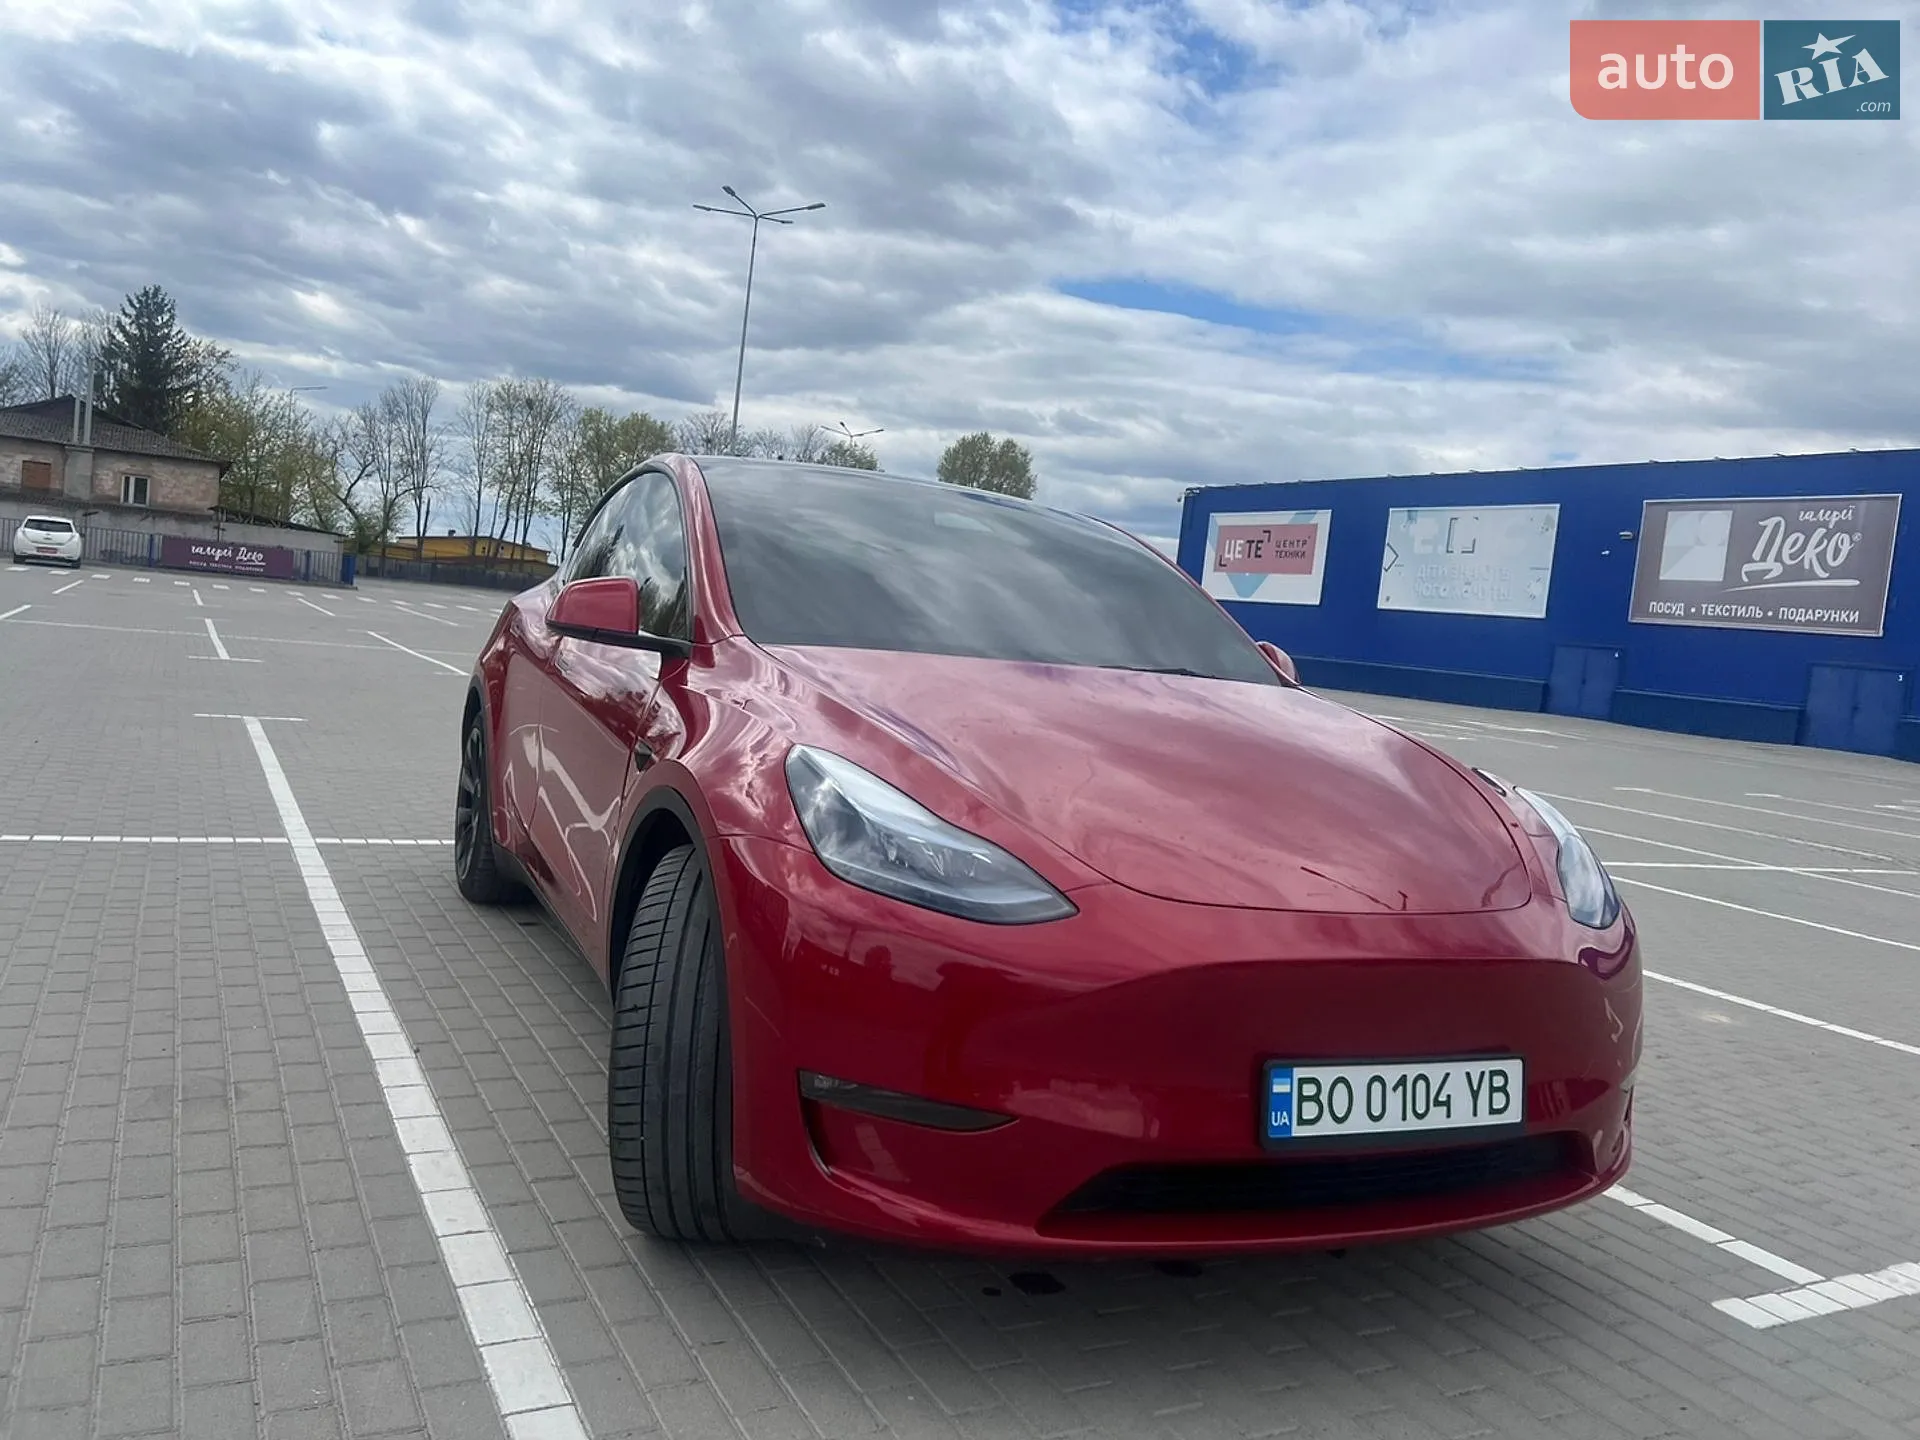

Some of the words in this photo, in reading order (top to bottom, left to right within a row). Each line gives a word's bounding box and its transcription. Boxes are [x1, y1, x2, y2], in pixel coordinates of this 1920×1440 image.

[1275, 540, 1308, 549] ЦЕНТР
[1649, 601, 1685, 616] ПОСУД
[1701, 603, 1763, 619] ТЕКСТИЛЬ
[1778, 607, 1860, 623] ПОДАРУНКИ
[1297, 1076, 1354, 1126] BO
[1366, 1072, 1451, 1122] 0104
[1465, 1069, 1511, 1117] YB
[1271, 1111, 1290, 1127] UA
